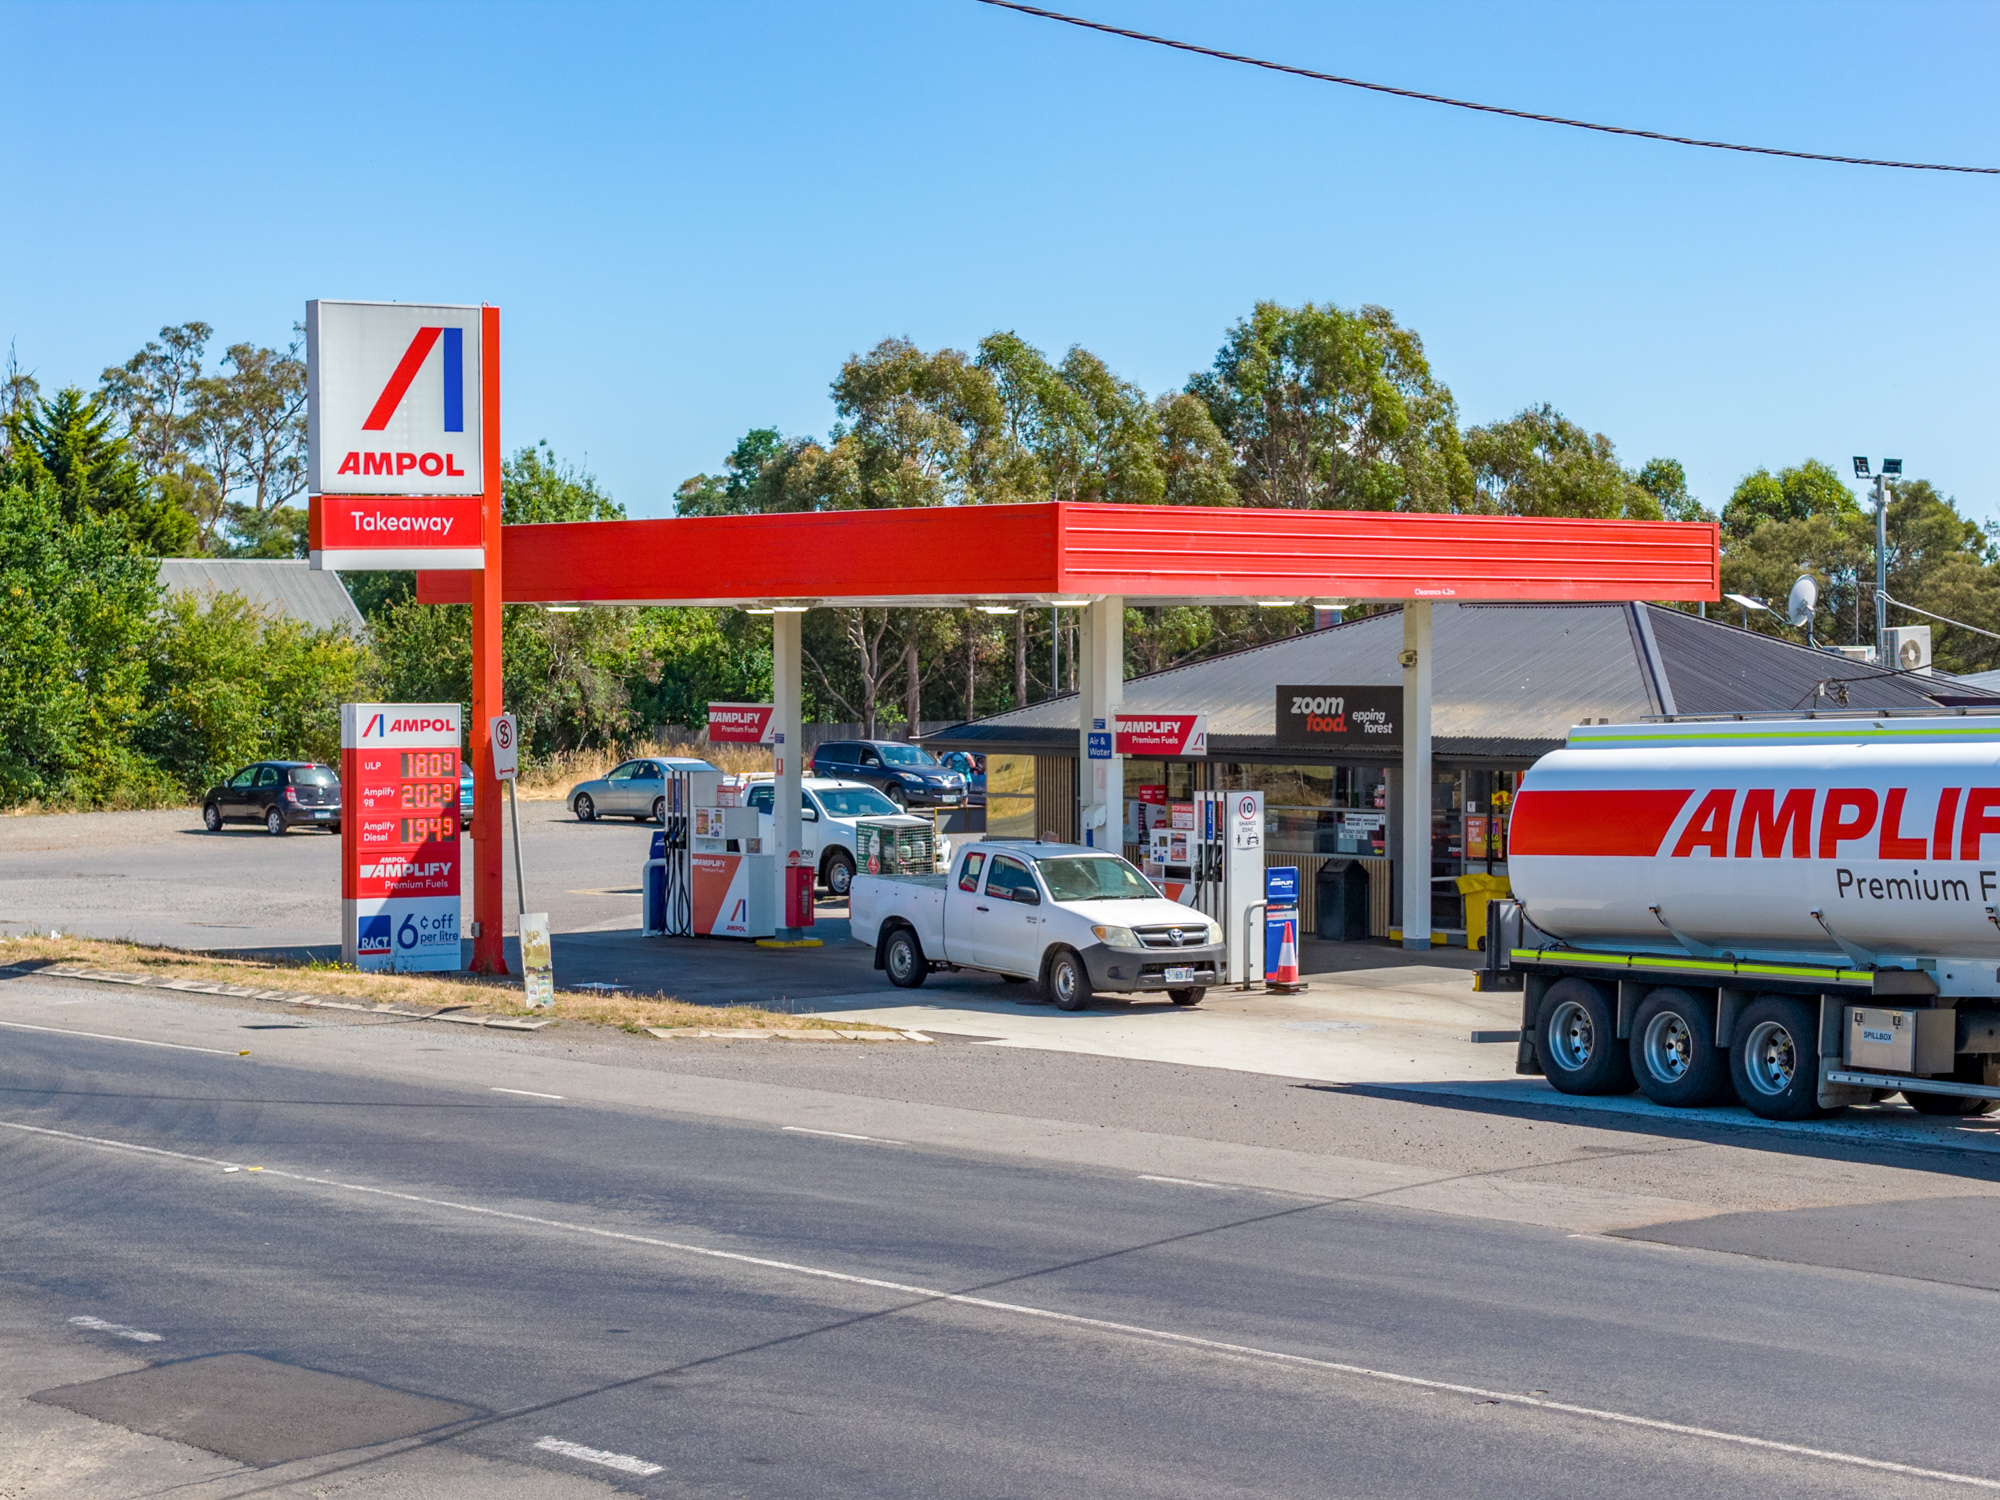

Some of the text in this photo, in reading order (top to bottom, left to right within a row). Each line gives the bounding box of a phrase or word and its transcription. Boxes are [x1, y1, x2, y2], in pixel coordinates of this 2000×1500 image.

[337, 451, 465, 477] AMPOL
[350, 511, 454, 536] Takeaway
[1414, 588, 1441, 596] Clearance
[1290, 696, 1344, 715] zoom
[715, 711, 760, 724] AMPLIFY
[1352, 707, 1386, 724] epping
[389, 718, 455, 732] AMPOL
[1123, 721, 1181, 734] AMPLIFY
[1306, 712, 1347, 733] food.
[1364, 721, 1393, 734] forest
[721, 724, 758, 734] Premium Fuels
[1089, 736, 1106, 746] Air &
[1131, 735, 1179, 745] Premium Fuels
[1089, 747, 1111, 757] Water
[364, 761, 382, 771] ULP
[363, 787, 396, 798] Amplify
[363, 798, 375, 808] 98
[1243, 802, 1253, 814] 10
[363, 821, 396, 832] Amplify
[363, 832, 389, 842] Diesel
[379, 856, 408, 864] AMPOL
[698, 859, 727, 867] AMPLIFY
[371, 862, 453, 879] AMPLIFY
[384, 879, 449, 890] Premium Fuels
[1836, 868, 1970, 902] Premium
[397, 913, 419, 949] 6
[432, 914, 453, 930] off
[361, 936, 389, 948] RACT
[420, 931, 459, 944] per litre
[1863, 1031, 1892, 1041] SPILLBOX
